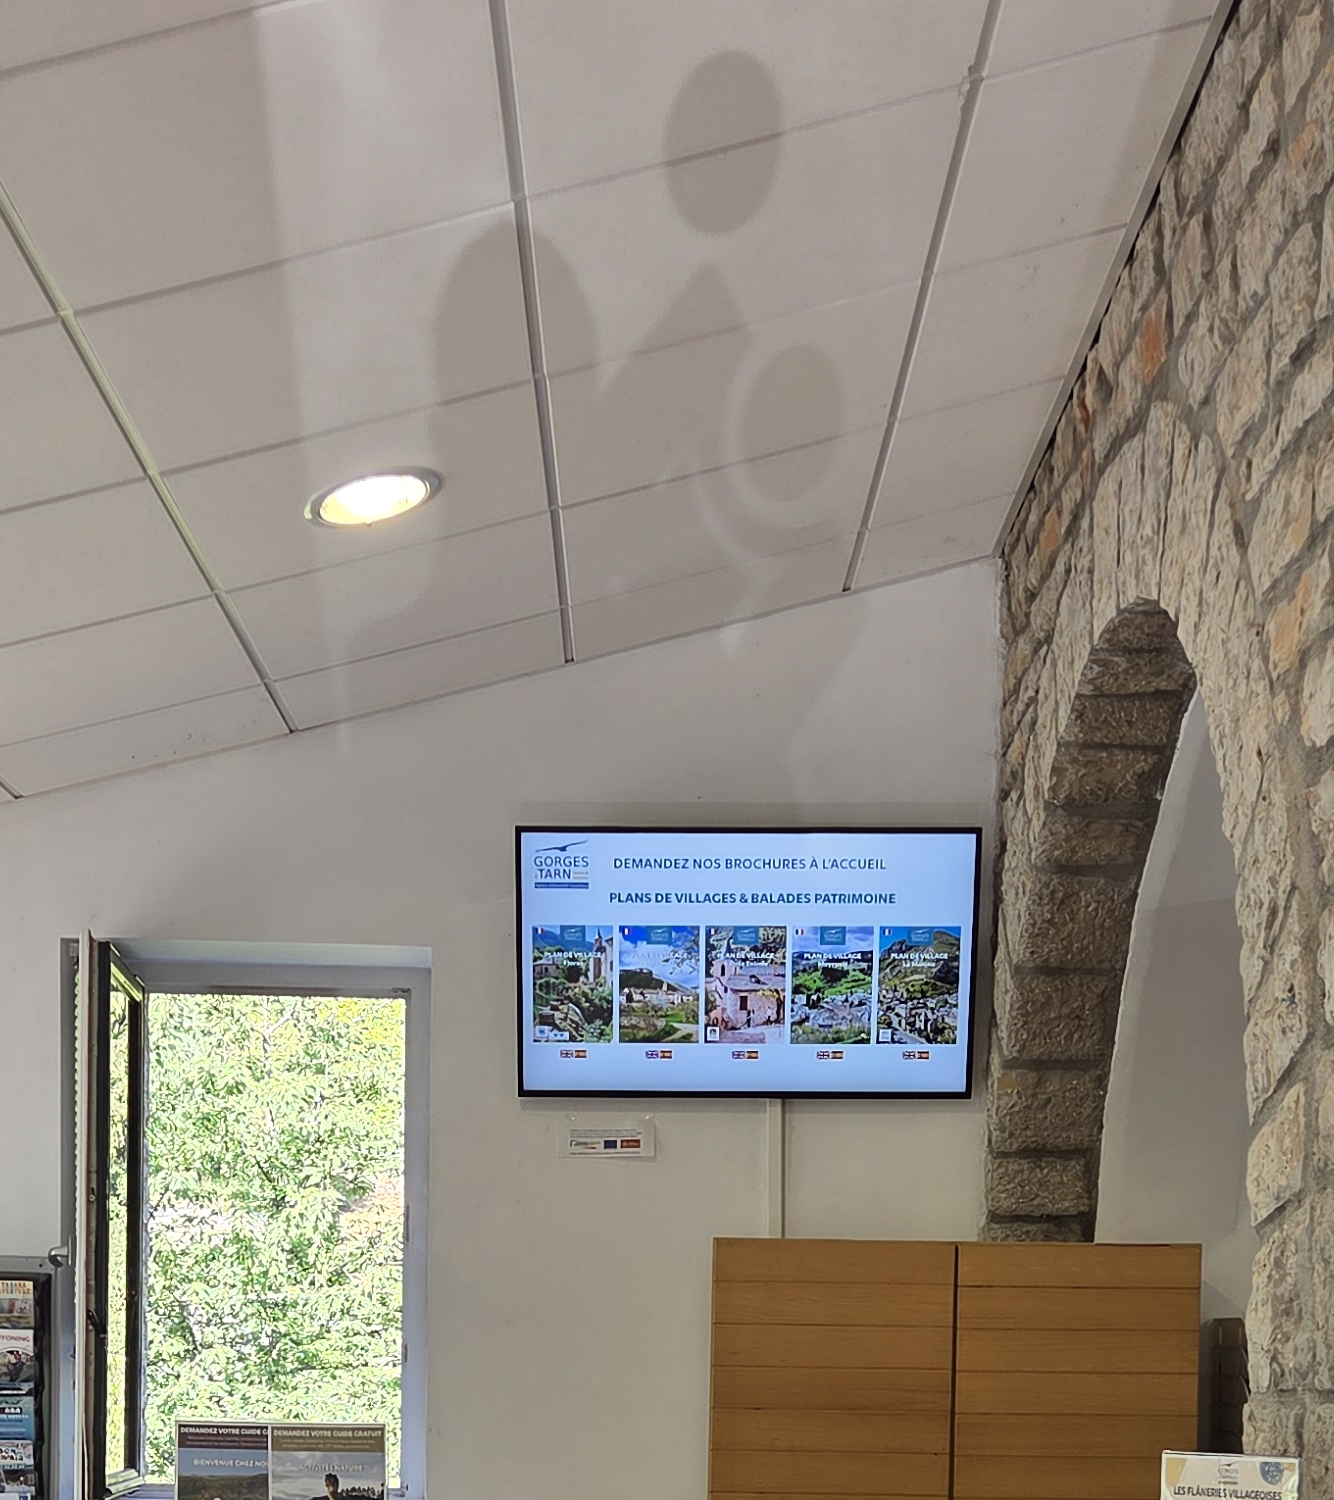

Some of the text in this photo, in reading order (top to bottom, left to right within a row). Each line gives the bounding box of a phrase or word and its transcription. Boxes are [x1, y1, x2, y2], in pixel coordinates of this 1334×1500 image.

[534, 856, 589, 868] GORGES
[613, 856, 886, 870] DEMANDEZ NOS BROCHURES À L'ACCUEIL
[537, 868, 571, 880] TARN
[609, 892, 897, 904] PLANS DE VILLAGES & BALADES PATRIMOINE
[194, 1459, 233, 1467] BIENVENUE
[1173, 1486, 1186, 1495] LES
[1228, 1489, 1282, 1500] VILLAGEOISES
